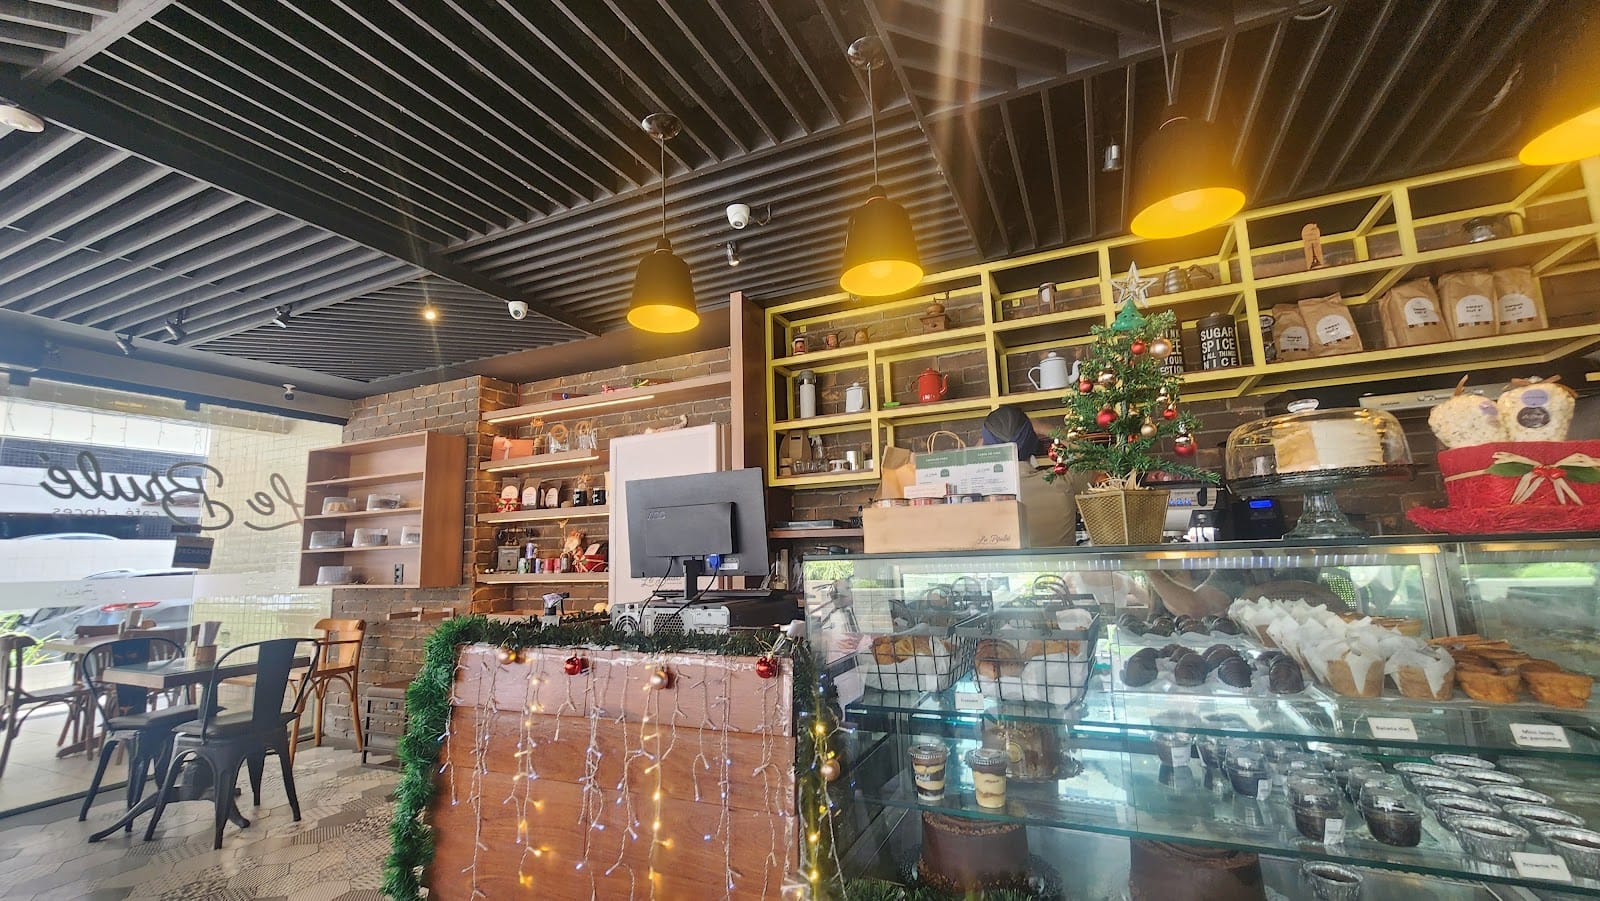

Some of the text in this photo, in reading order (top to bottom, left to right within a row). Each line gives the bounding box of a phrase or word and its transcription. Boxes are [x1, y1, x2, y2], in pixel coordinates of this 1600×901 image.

[1200, 326, 1234, 341] SUGAR
[1201, 338, 1236, 354] SPICE
[1163, 355, 1184, 366] YOUR
[1207, 352, 1217, 360] ALL
[1203, 357, 1237, 371] NICE
